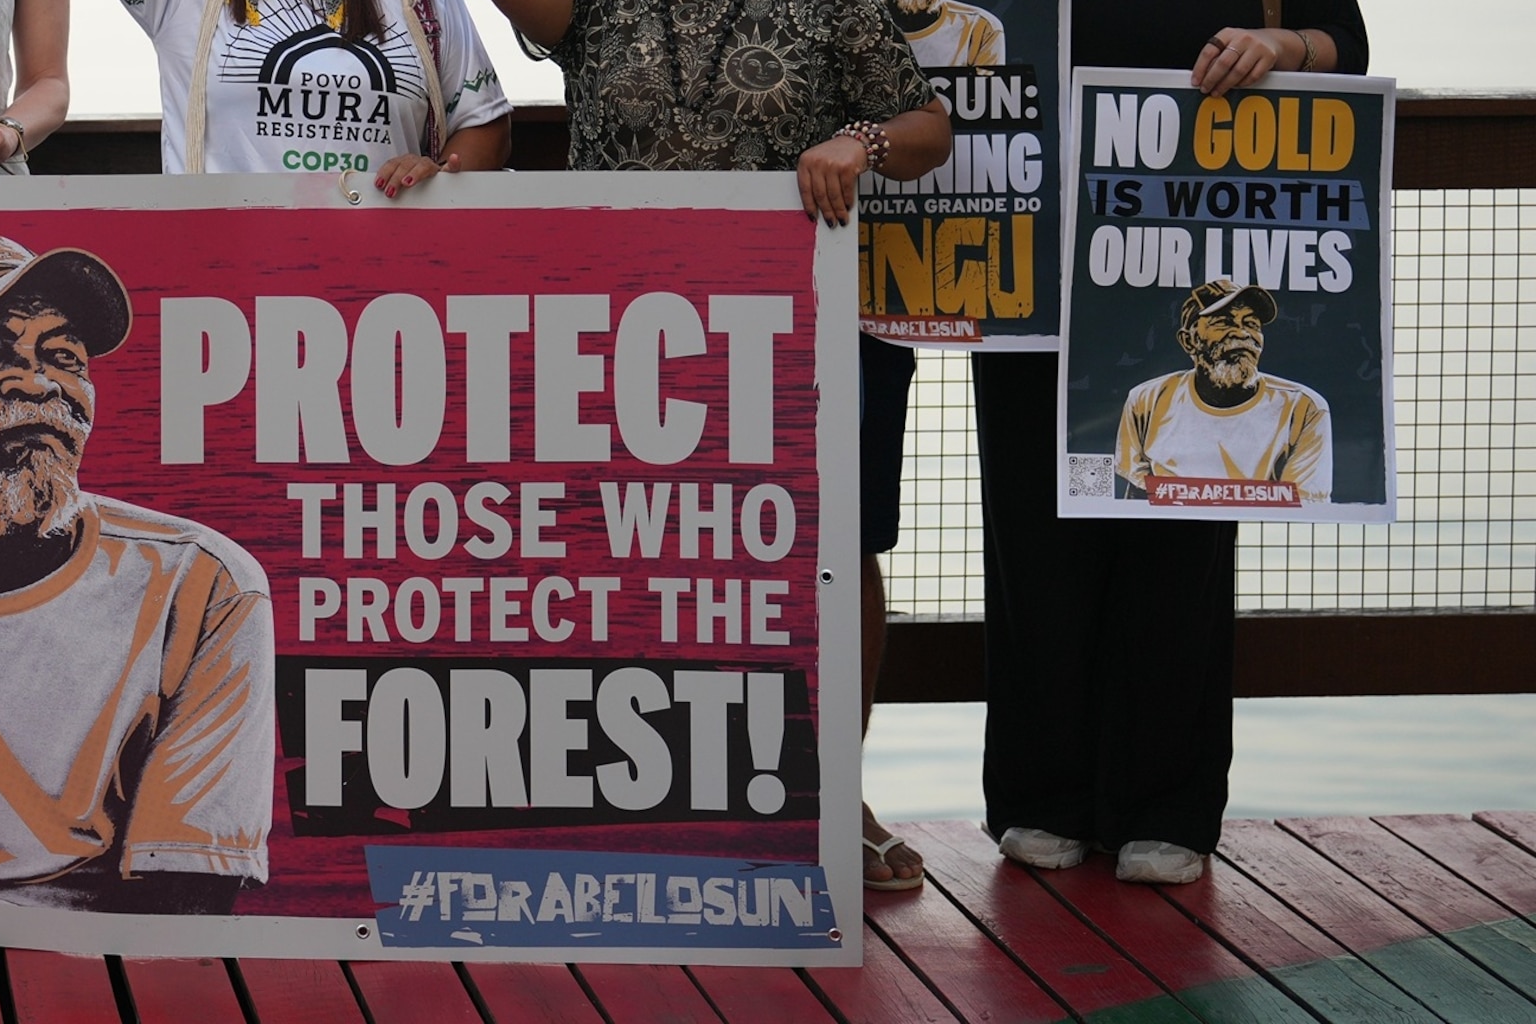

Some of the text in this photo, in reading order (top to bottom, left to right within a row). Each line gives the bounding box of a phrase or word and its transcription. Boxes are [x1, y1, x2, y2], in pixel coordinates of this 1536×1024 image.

[257, 86, 391, 126] MURA
[301, 72, 361, 89] POVO
[256, 121, 392, 145] RESISTÊNCIA
[282, 149, 369, 172] COP30
[1093, 93, 1355, 172] NO GOLD
[859, 132, 1043, 195] NING
[858, 197, 1042, 215] VOLTA GRANDE DO
[1096, 179, 1350, 221] IS WORTH
[1088, 225, 1354, 293] OUR LIVES
[160, 291, 794, 466] PROTECT
[1155, 483, 1293, 502] #FORABELOSUN
[287, 481, 796, 563] THOSE WHO
[298, 576, 790, 647] PROTECT THE
[305, 667, 786, 815] FOREST!
[399, 871, 814, 927] #FORABELOSUN
